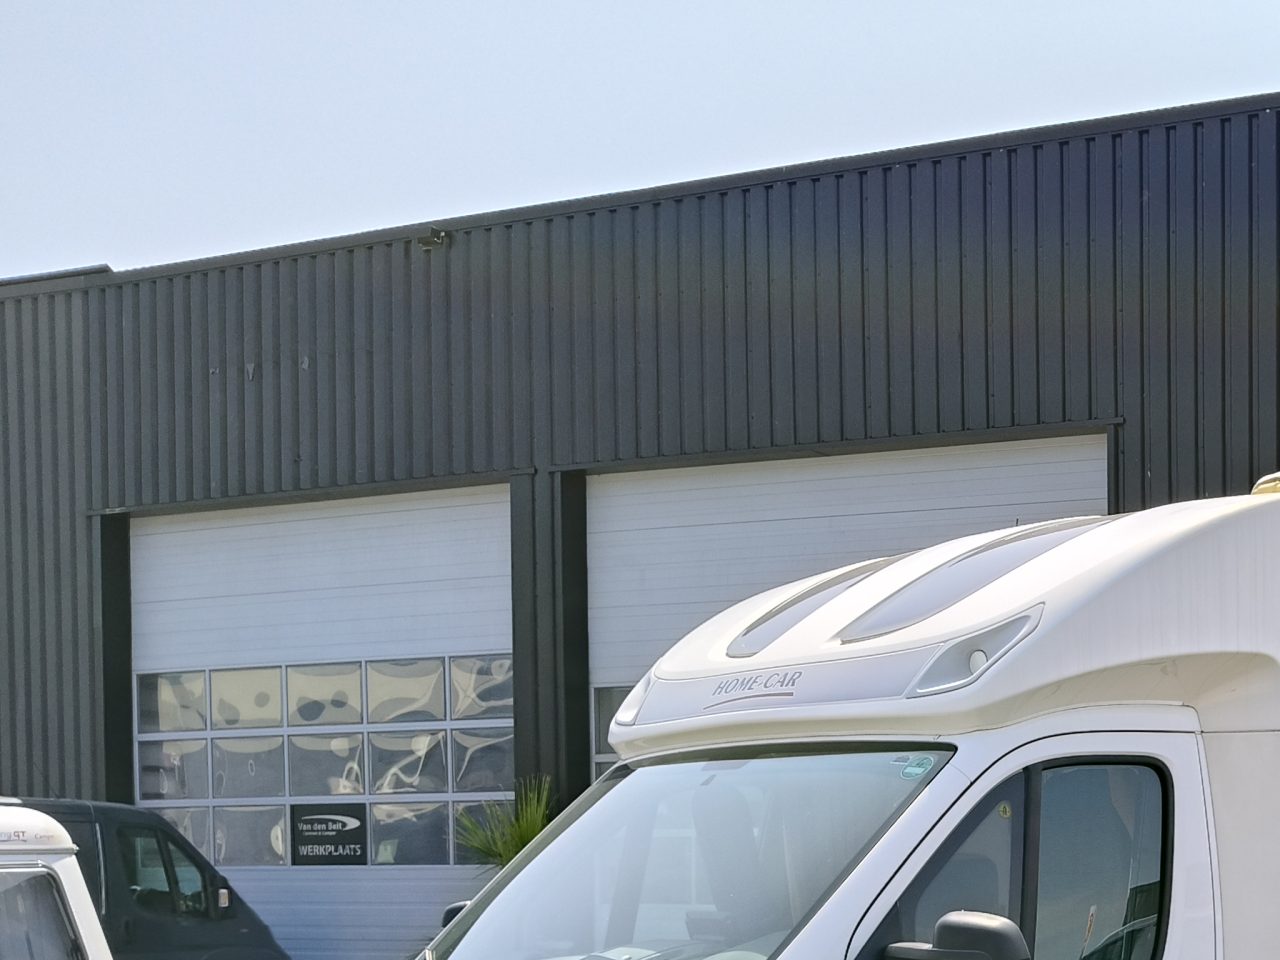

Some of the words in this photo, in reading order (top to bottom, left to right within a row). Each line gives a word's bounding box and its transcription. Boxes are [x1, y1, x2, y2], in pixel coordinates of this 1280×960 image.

[712, 671, 803, 697] HOME-CAR
[298, 822, 312, 831] Van
[313, 822, 326, 831] den
[328, 821, 343, 831] Belt
[299, 844, 361, 856] WERKPLAATS
